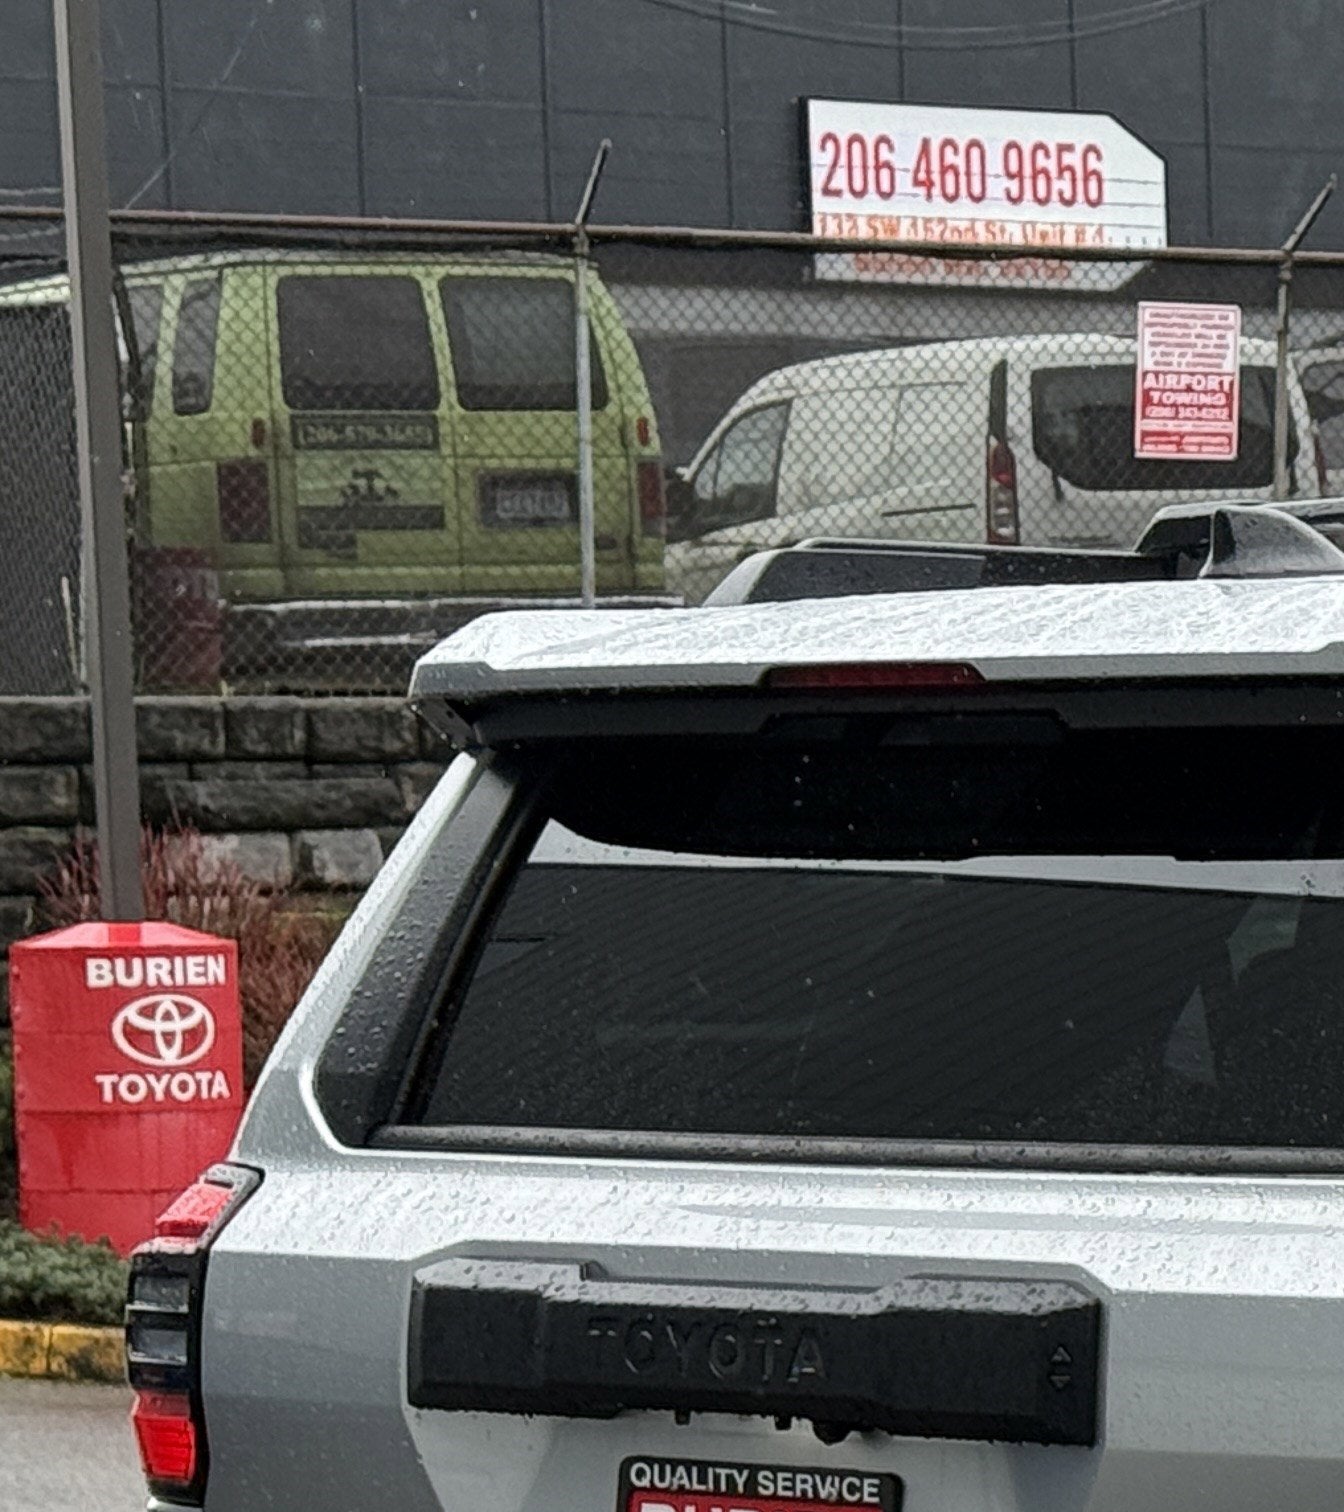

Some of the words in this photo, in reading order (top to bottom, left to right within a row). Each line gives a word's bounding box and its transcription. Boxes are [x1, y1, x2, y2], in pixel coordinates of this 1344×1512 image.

[819, 132, 896, 199] 206
[912, 137, 987, 204] 460
[1002, 140, 1104, 208] 9656
[1143, 373, 1234, 393] AIRPORT
[1150, 391, 1227, 406] TOWING
[86, 954, 226, 988] BURIEN
[95, 1070, 231, 1103] TOYOTA
[588, 1316, 827, 1383] TOYOTA
[630, 1462, 749, 1493] QUALITY
[757, 1473, 881, 1502] SERVICE
